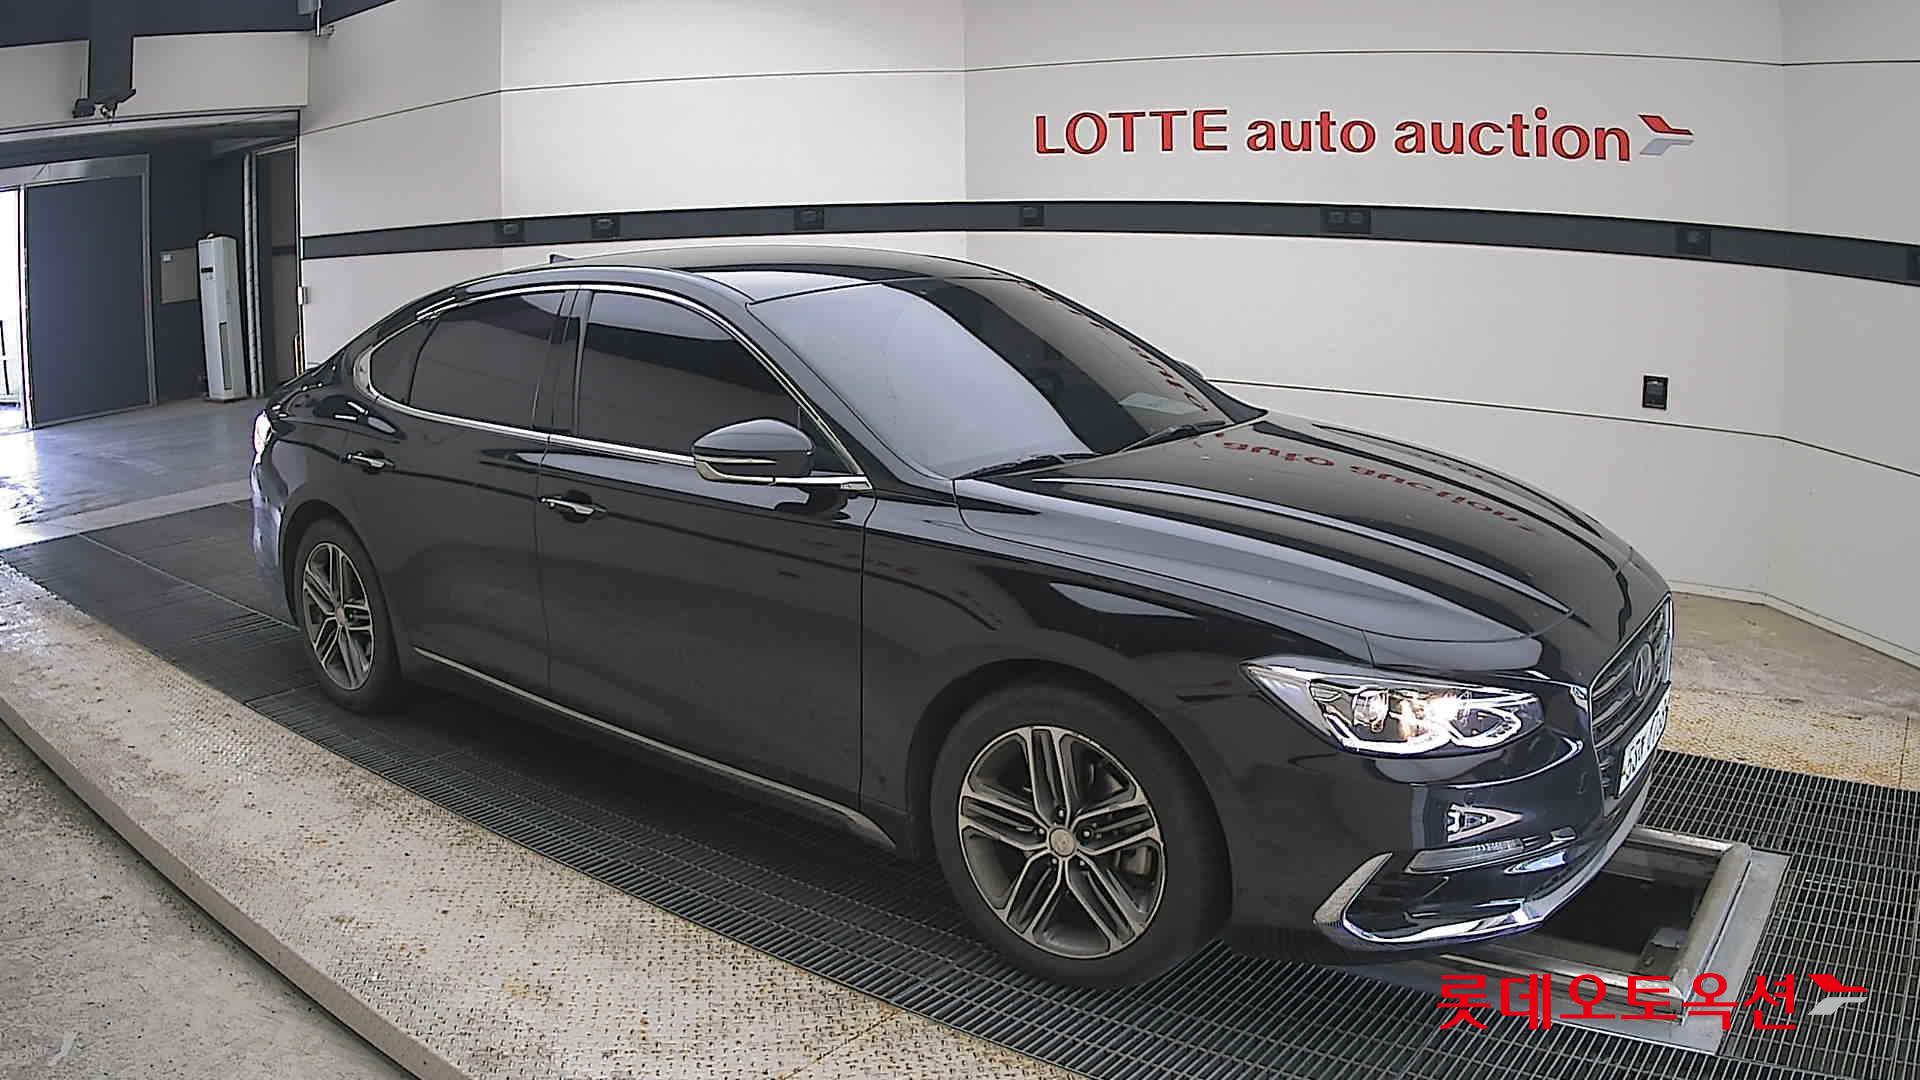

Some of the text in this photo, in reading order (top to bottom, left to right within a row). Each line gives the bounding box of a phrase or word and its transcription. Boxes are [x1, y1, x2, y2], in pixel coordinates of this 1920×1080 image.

[1034, 106, 1632, 162] LOTTE auto auction
